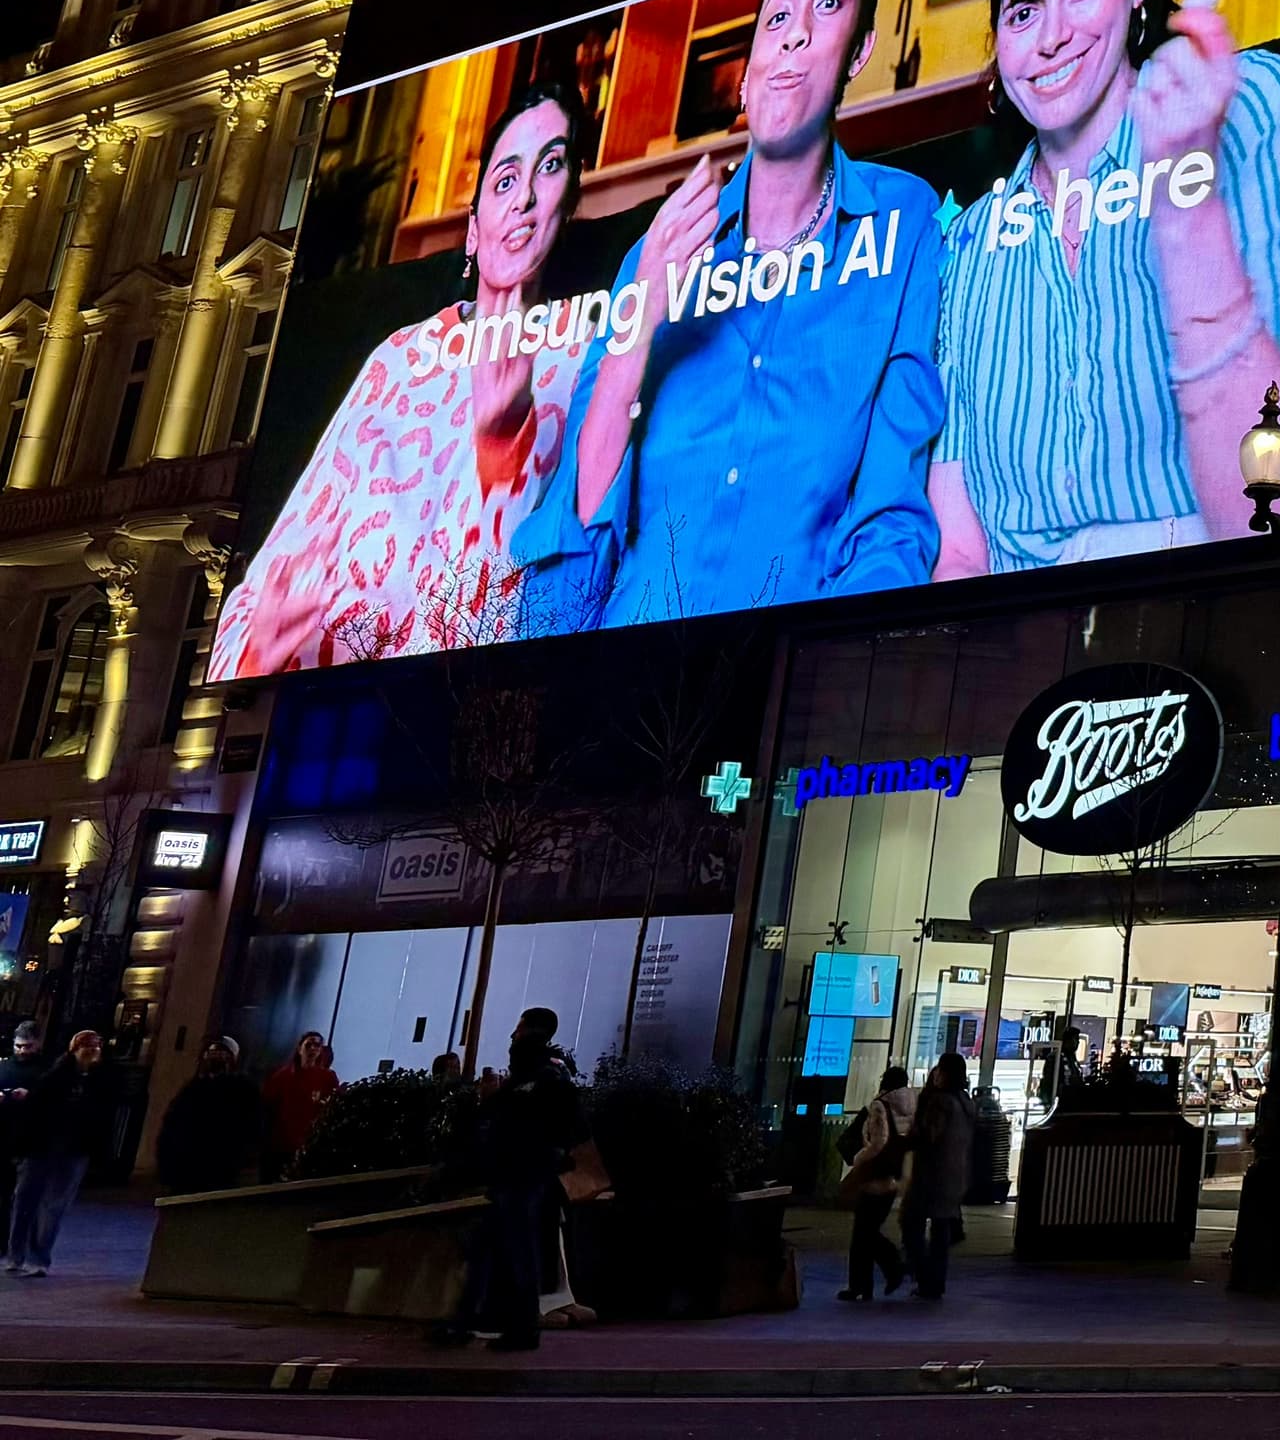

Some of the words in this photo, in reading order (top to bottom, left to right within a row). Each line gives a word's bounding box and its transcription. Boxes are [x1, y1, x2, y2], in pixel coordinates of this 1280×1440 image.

[412, 277, 649, 379] Samsung
[663, 239, 824, 325] Vision
[838, 208, 902, 286] AI
[984, 174, 1037, 253] is
[1051, 150, 1216, 241] here
[1014, 690, 1189, 823] Boots
[795, 754, 972, 810] pharmacy
[164, 838, 200, 849] oasis
[390, 844, 459, 880] oasis
[957, 968, 979, 983] DIOR
[1023, 1026, 1051, 1045] DIOR
